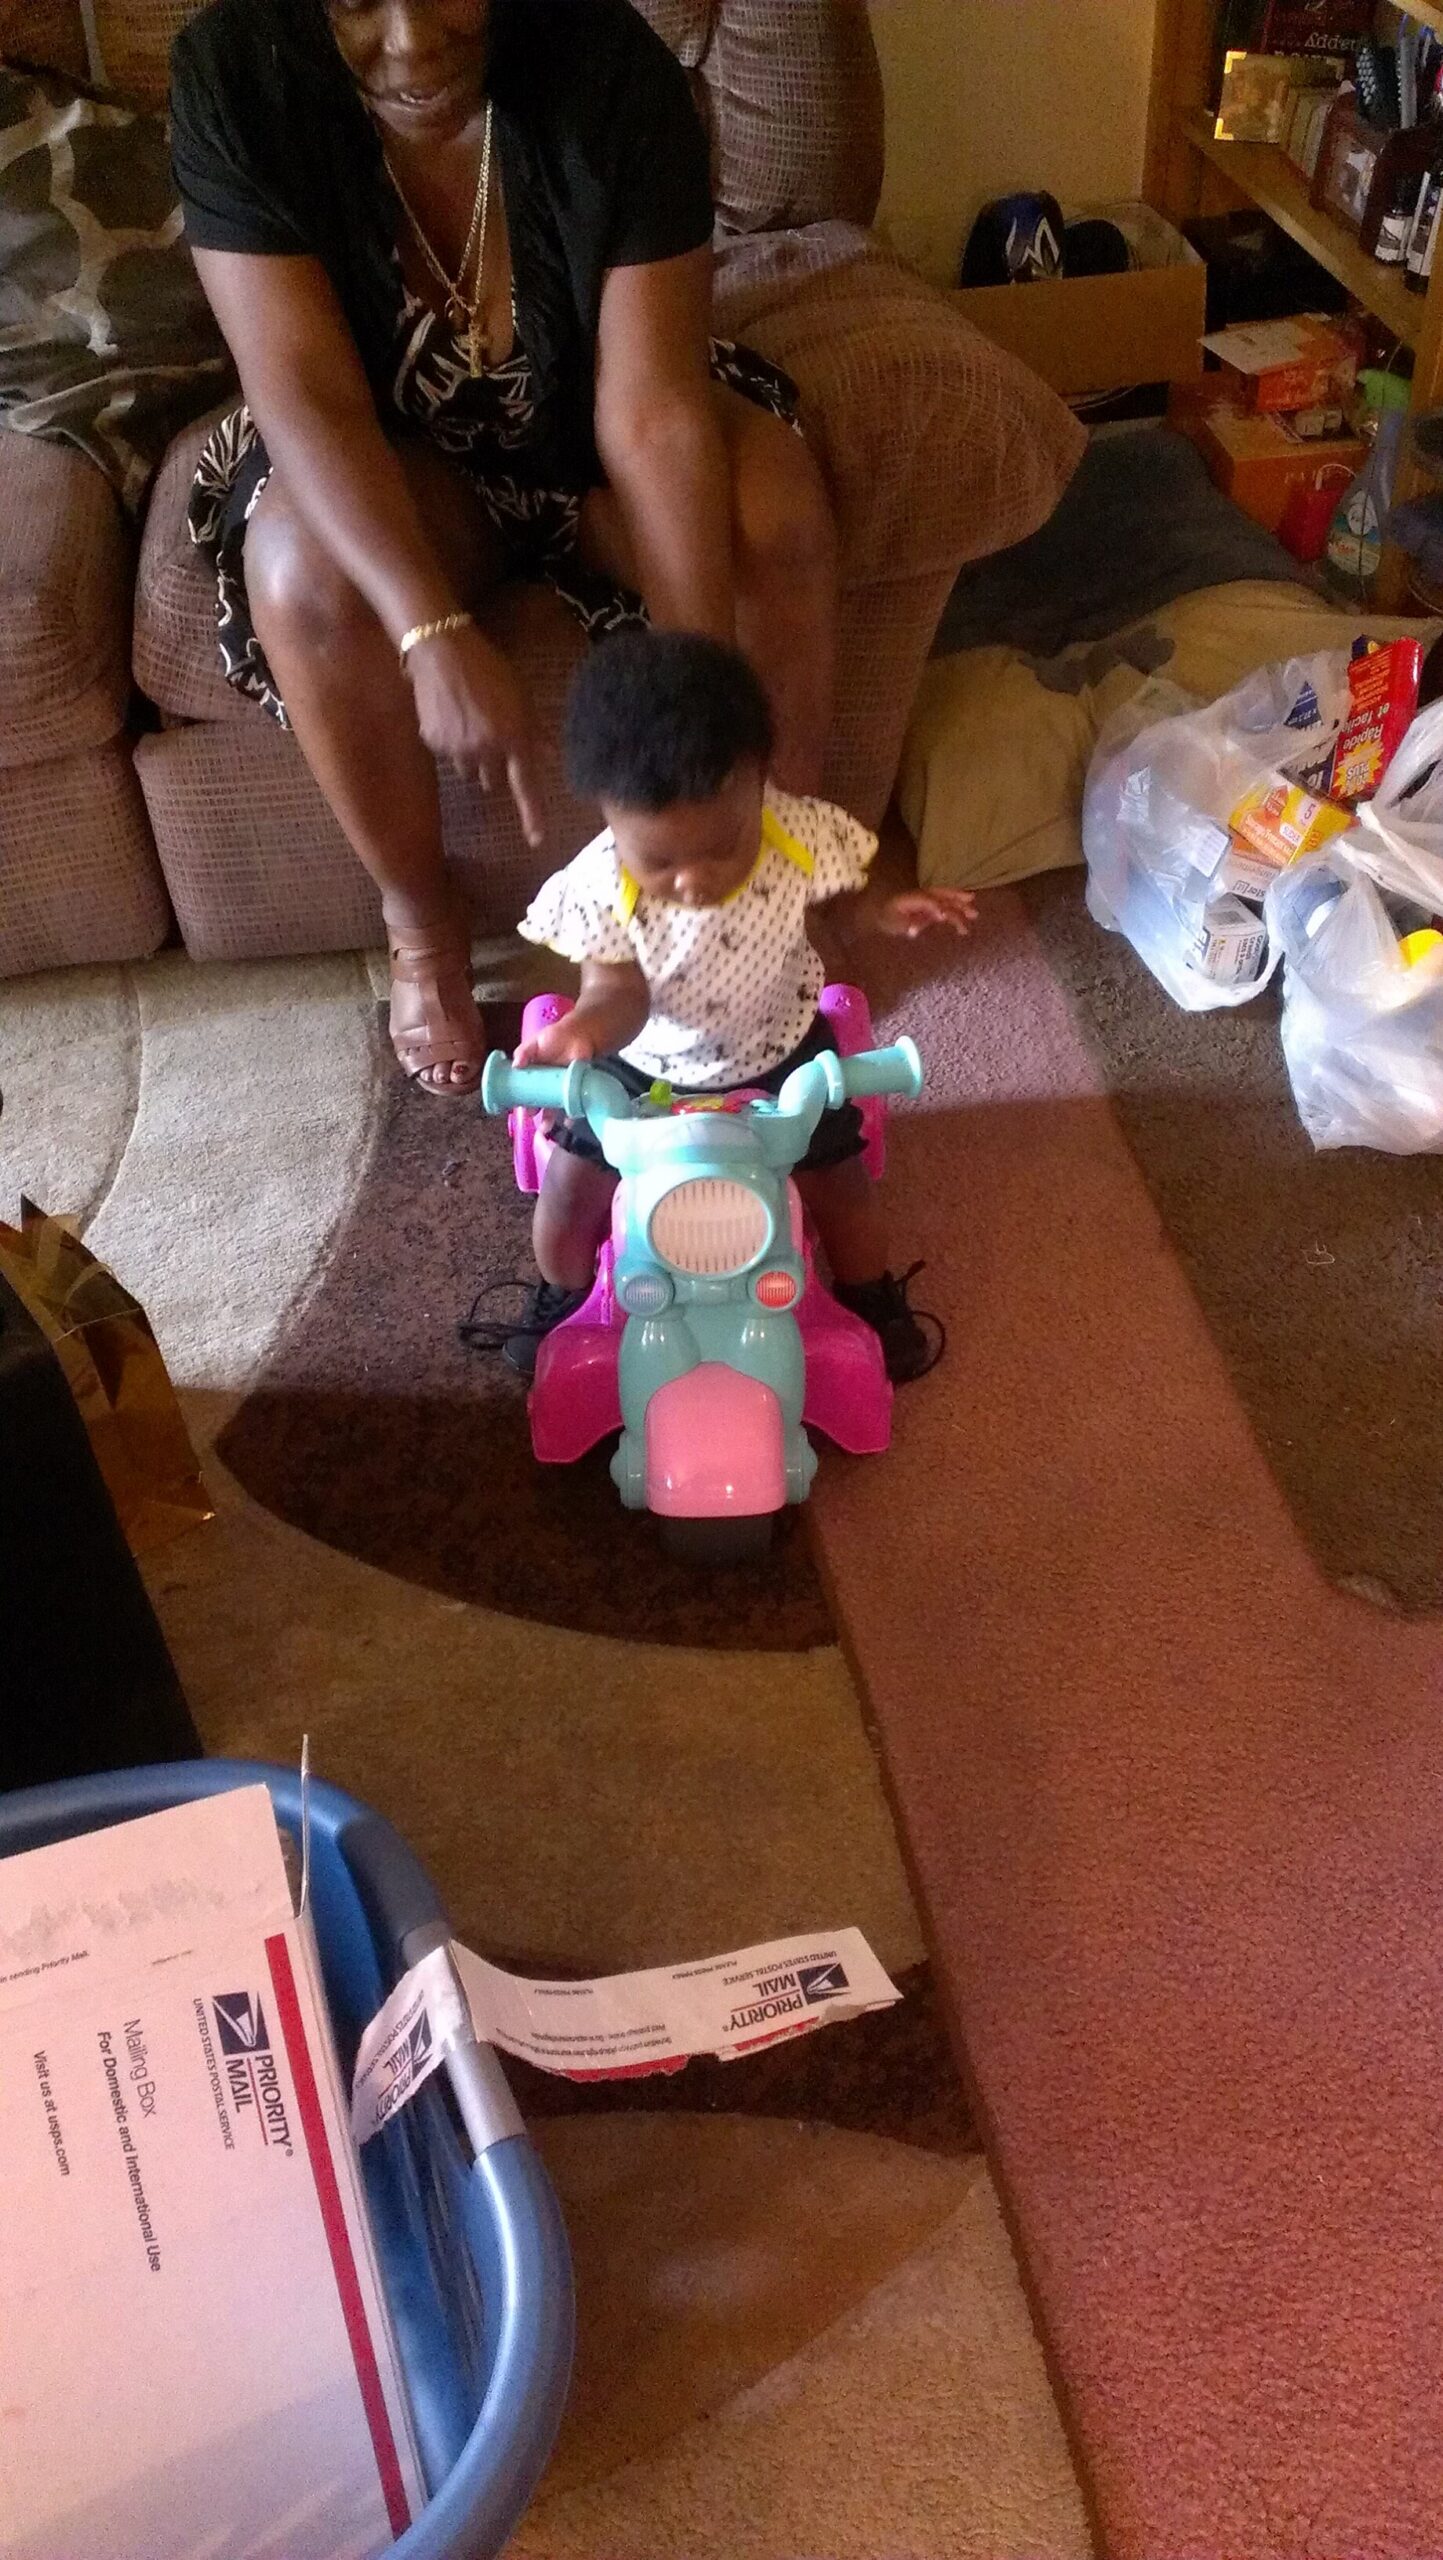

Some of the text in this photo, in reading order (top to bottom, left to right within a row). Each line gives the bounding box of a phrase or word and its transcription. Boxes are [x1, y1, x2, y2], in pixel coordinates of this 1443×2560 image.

[1343, 724, 1384, 750] Rapide
[41, 1955, 70, 1971] Priority
[722, 1970, 754, 1986] SERVICE
[756, 1960, 782, 1975] POSTAL
[752, 1972, 796, 1996] MAIL
[122, 2017, 158, 2119] Mailing Box
[193, 1998, 235, 2150] UNITED STATES POSTAL SERVICE
[383, 2037, 411, 2075] MAIL
[225, 2058, 252, 2113] MAIL
[33, 2050, 72, 2176] Visit us at usps.com
[97, 2031, 163, 2272] For Domestic and International Use
